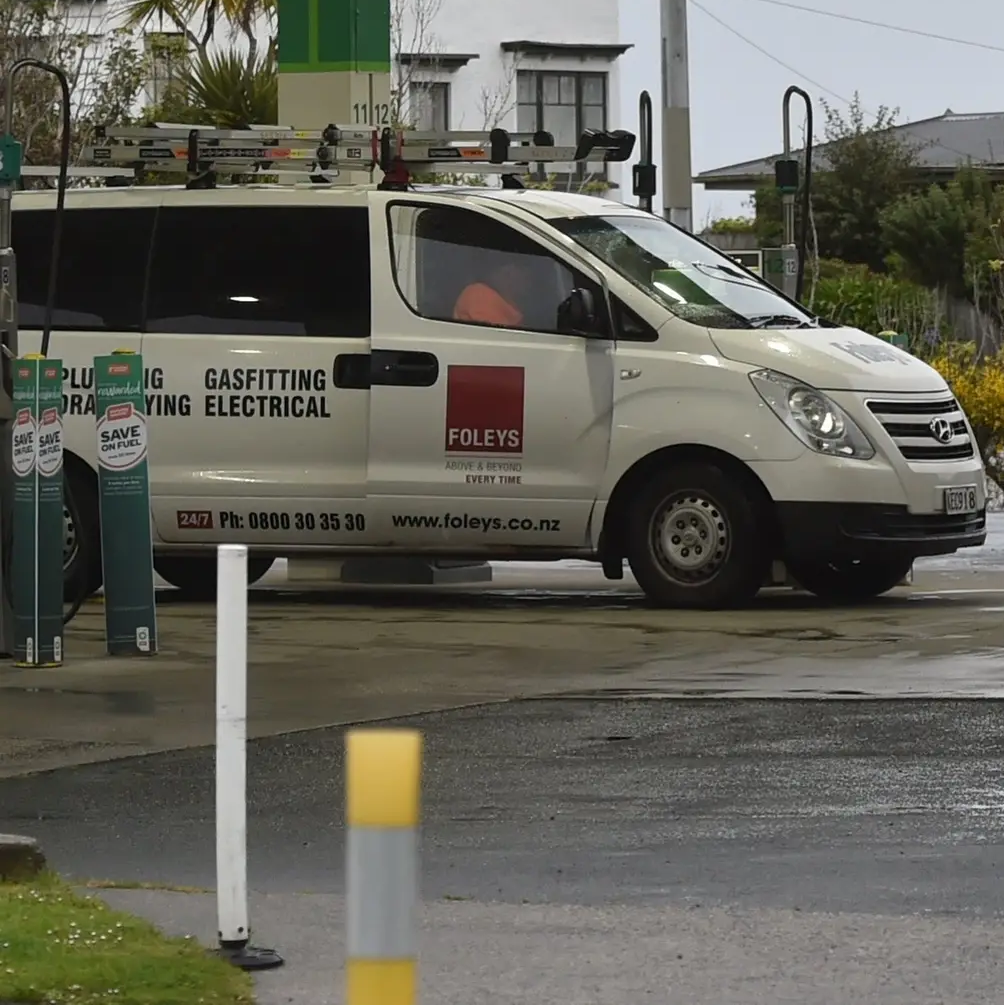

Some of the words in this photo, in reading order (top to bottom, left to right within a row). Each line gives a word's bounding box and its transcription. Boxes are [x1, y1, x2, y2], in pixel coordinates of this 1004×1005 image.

[353, 103, 367, 125] 11
[374, 103, 389, 125] 12
[204, 368, 326, 391] GASFITTING
[204, 395, 331, 418] ELECTRICAL
[14, 431, 34, 447] SAVE
[39, 430, 61, 448] SAVE
[101, 425, 141, 443] SAVE
[448, 428, 519, 447] FOLEYS
[101, 443, 117, 452] ON
[117, 439, 142, 450] FUEL
[445, 461, 475, 471] ABOVE
[477, 462, 484, 471] &
[486, 462, 522, 472] BEYOND
[465, 475, 496, 484] EVERY
[496, 475, 522, 485] TIME
[180, 512, 210, 526] 24/7
[219, 511, 244, 529] Ph:
[248, 512, 290, 530] 0800
[295, 512, 315, 530] 30
[319, 513, 341, 531] 35
[344, 513, 366, 531] 30
[392, 512, 561, 533] www.foleys.co.nz
